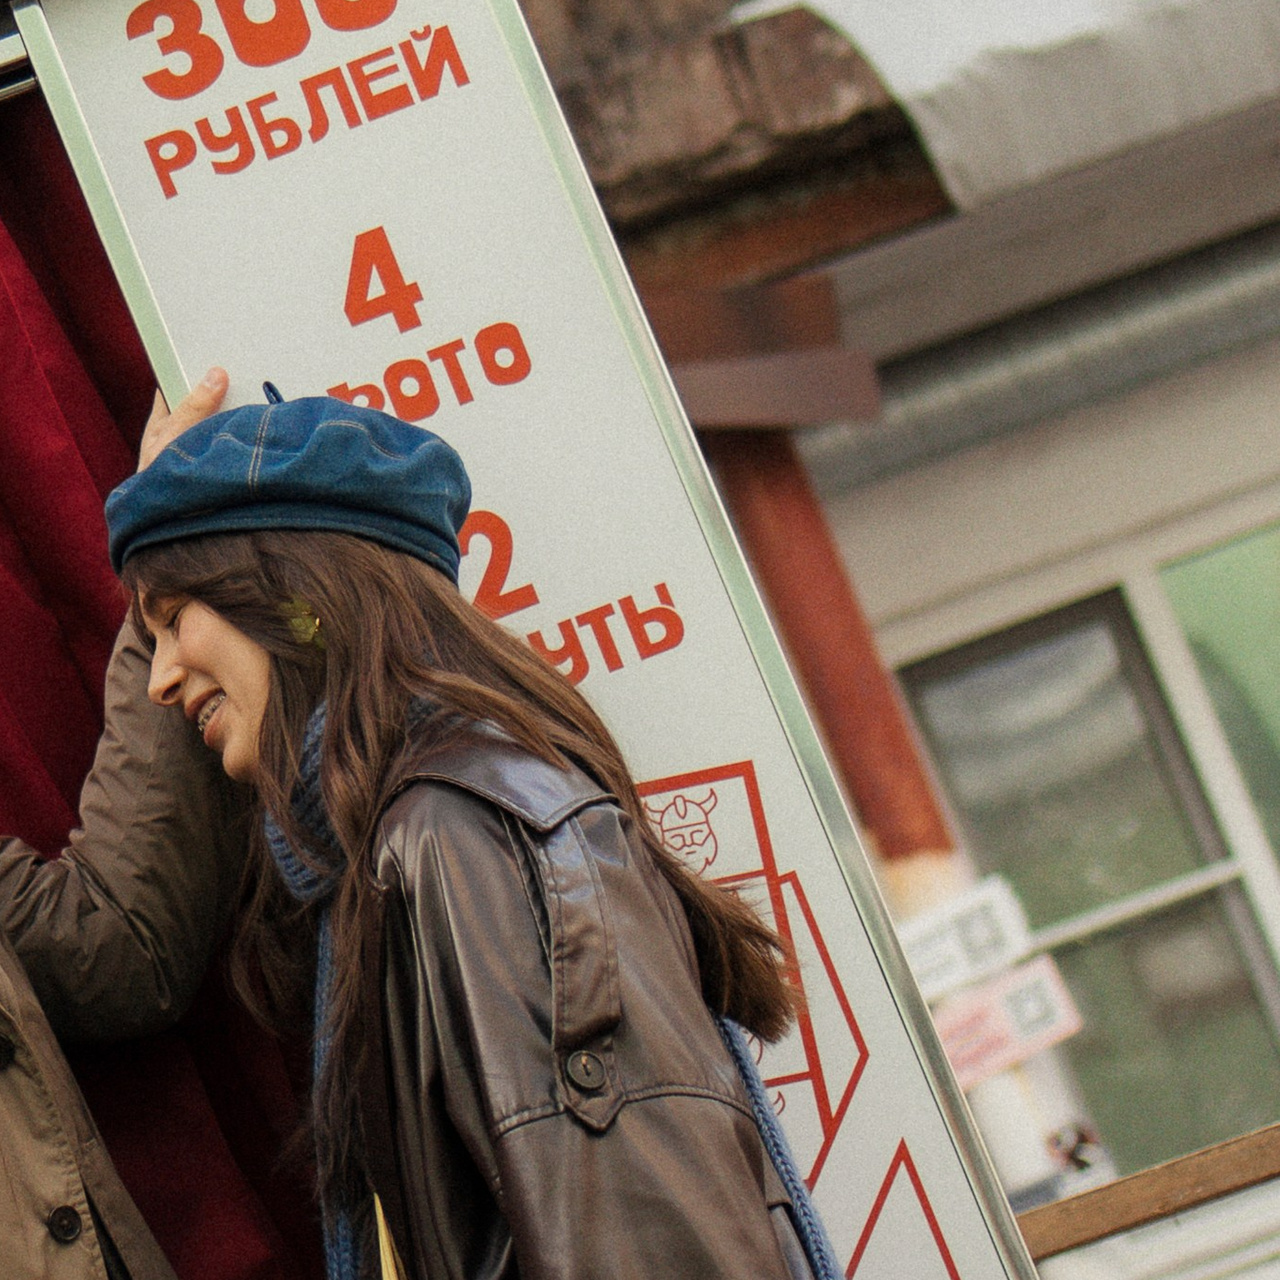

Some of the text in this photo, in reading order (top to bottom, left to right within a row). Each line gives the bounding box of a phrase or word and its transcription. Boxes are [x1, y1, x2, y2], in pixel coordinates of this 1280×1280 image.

[144, 23, 470, 199] РУБЛЕЙ
[343, 225, 424, 334] 4
[457, 510, 540, 620] 2
[526, 582, 685, 687] УТЫ
